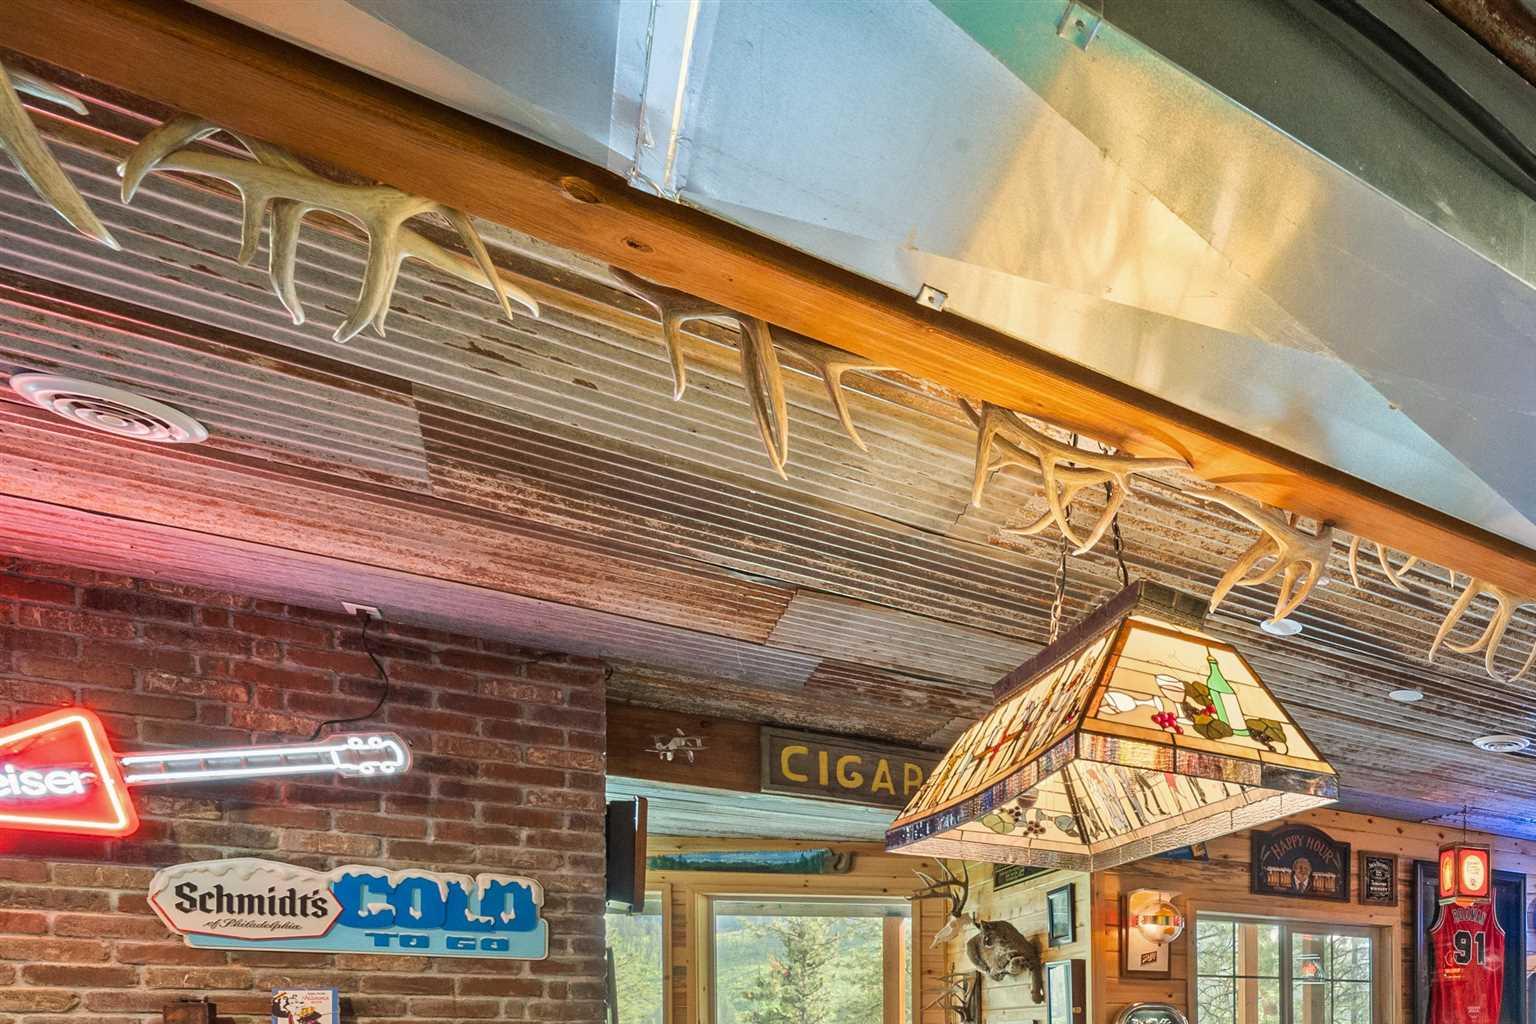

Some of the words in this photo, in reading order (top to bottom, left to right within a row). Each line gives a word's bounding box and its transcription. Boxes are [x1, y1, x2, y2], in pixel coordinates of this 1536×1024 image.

[1270, 835, 1303, 861] HAPPY
[1306, 836, 1335, 863] HOUR
[174, 881, 328, 920] Schmidt's
[333, 871, 540, 933] COLD
[203, 918, 220, 930] of
[219, 918, 303, 932] Philadelphia
[365, 932, 430, 949] TO
[446, 935, 511, 952] GO
[1453, 930, 1487, 966] 91
